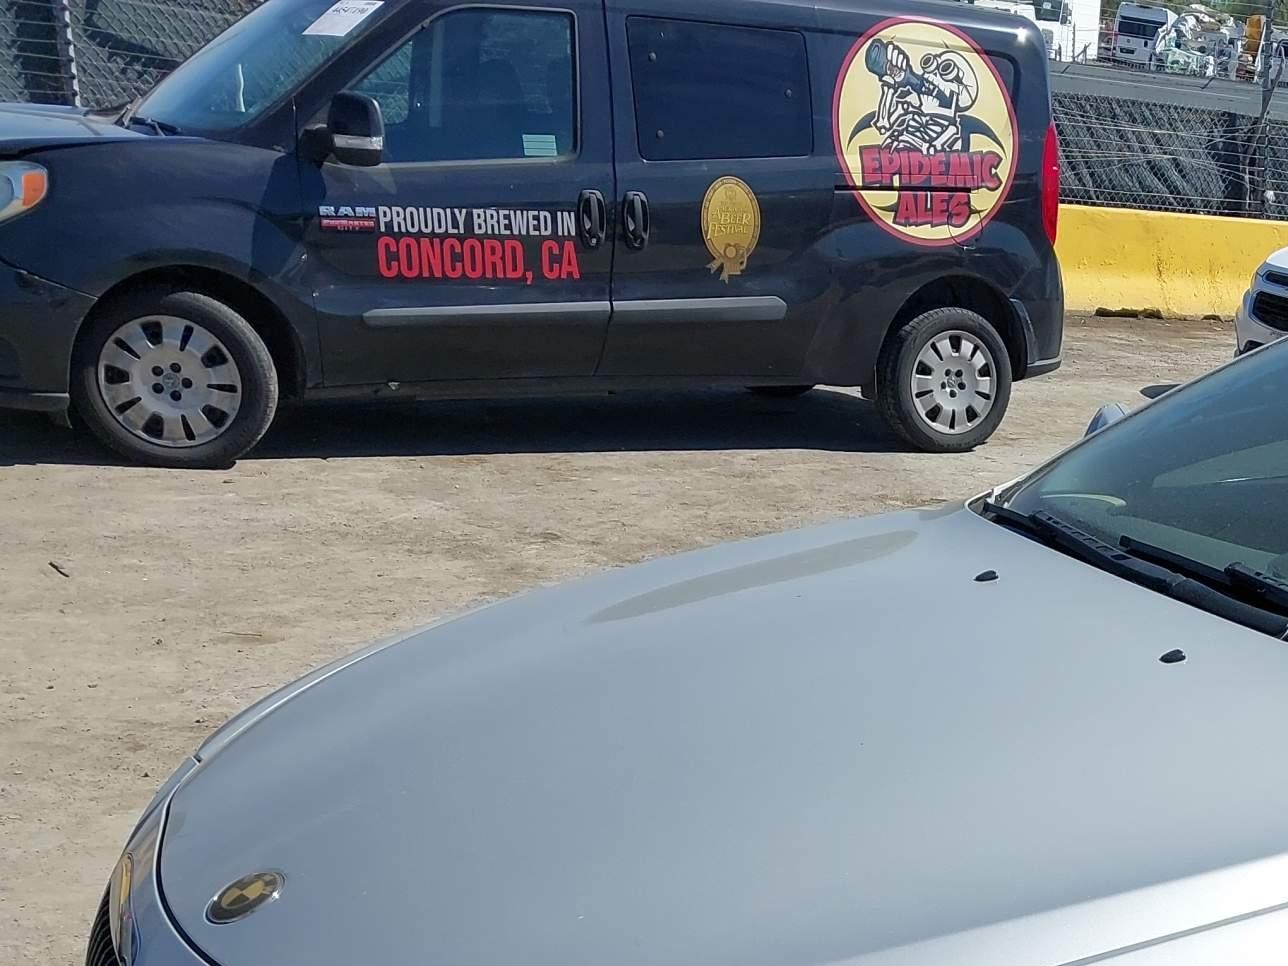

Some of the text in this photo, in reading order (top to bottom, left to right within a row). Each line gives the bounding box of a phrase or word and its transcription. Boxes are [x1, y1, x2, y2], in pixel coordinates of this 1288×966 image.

[859, 144, 1003, 190] EPIDEMIC
[319, 206, 376, 217] RAM
[379, 206, 576, 236] PROUDLY BREWED IN
[720, 212, 751, 225] BEER
[893, 190, 972, 228] ALES
[707, 222, 748, 240] FESTIVAL
[377, 236, 581, 284] CONCORD, CA
